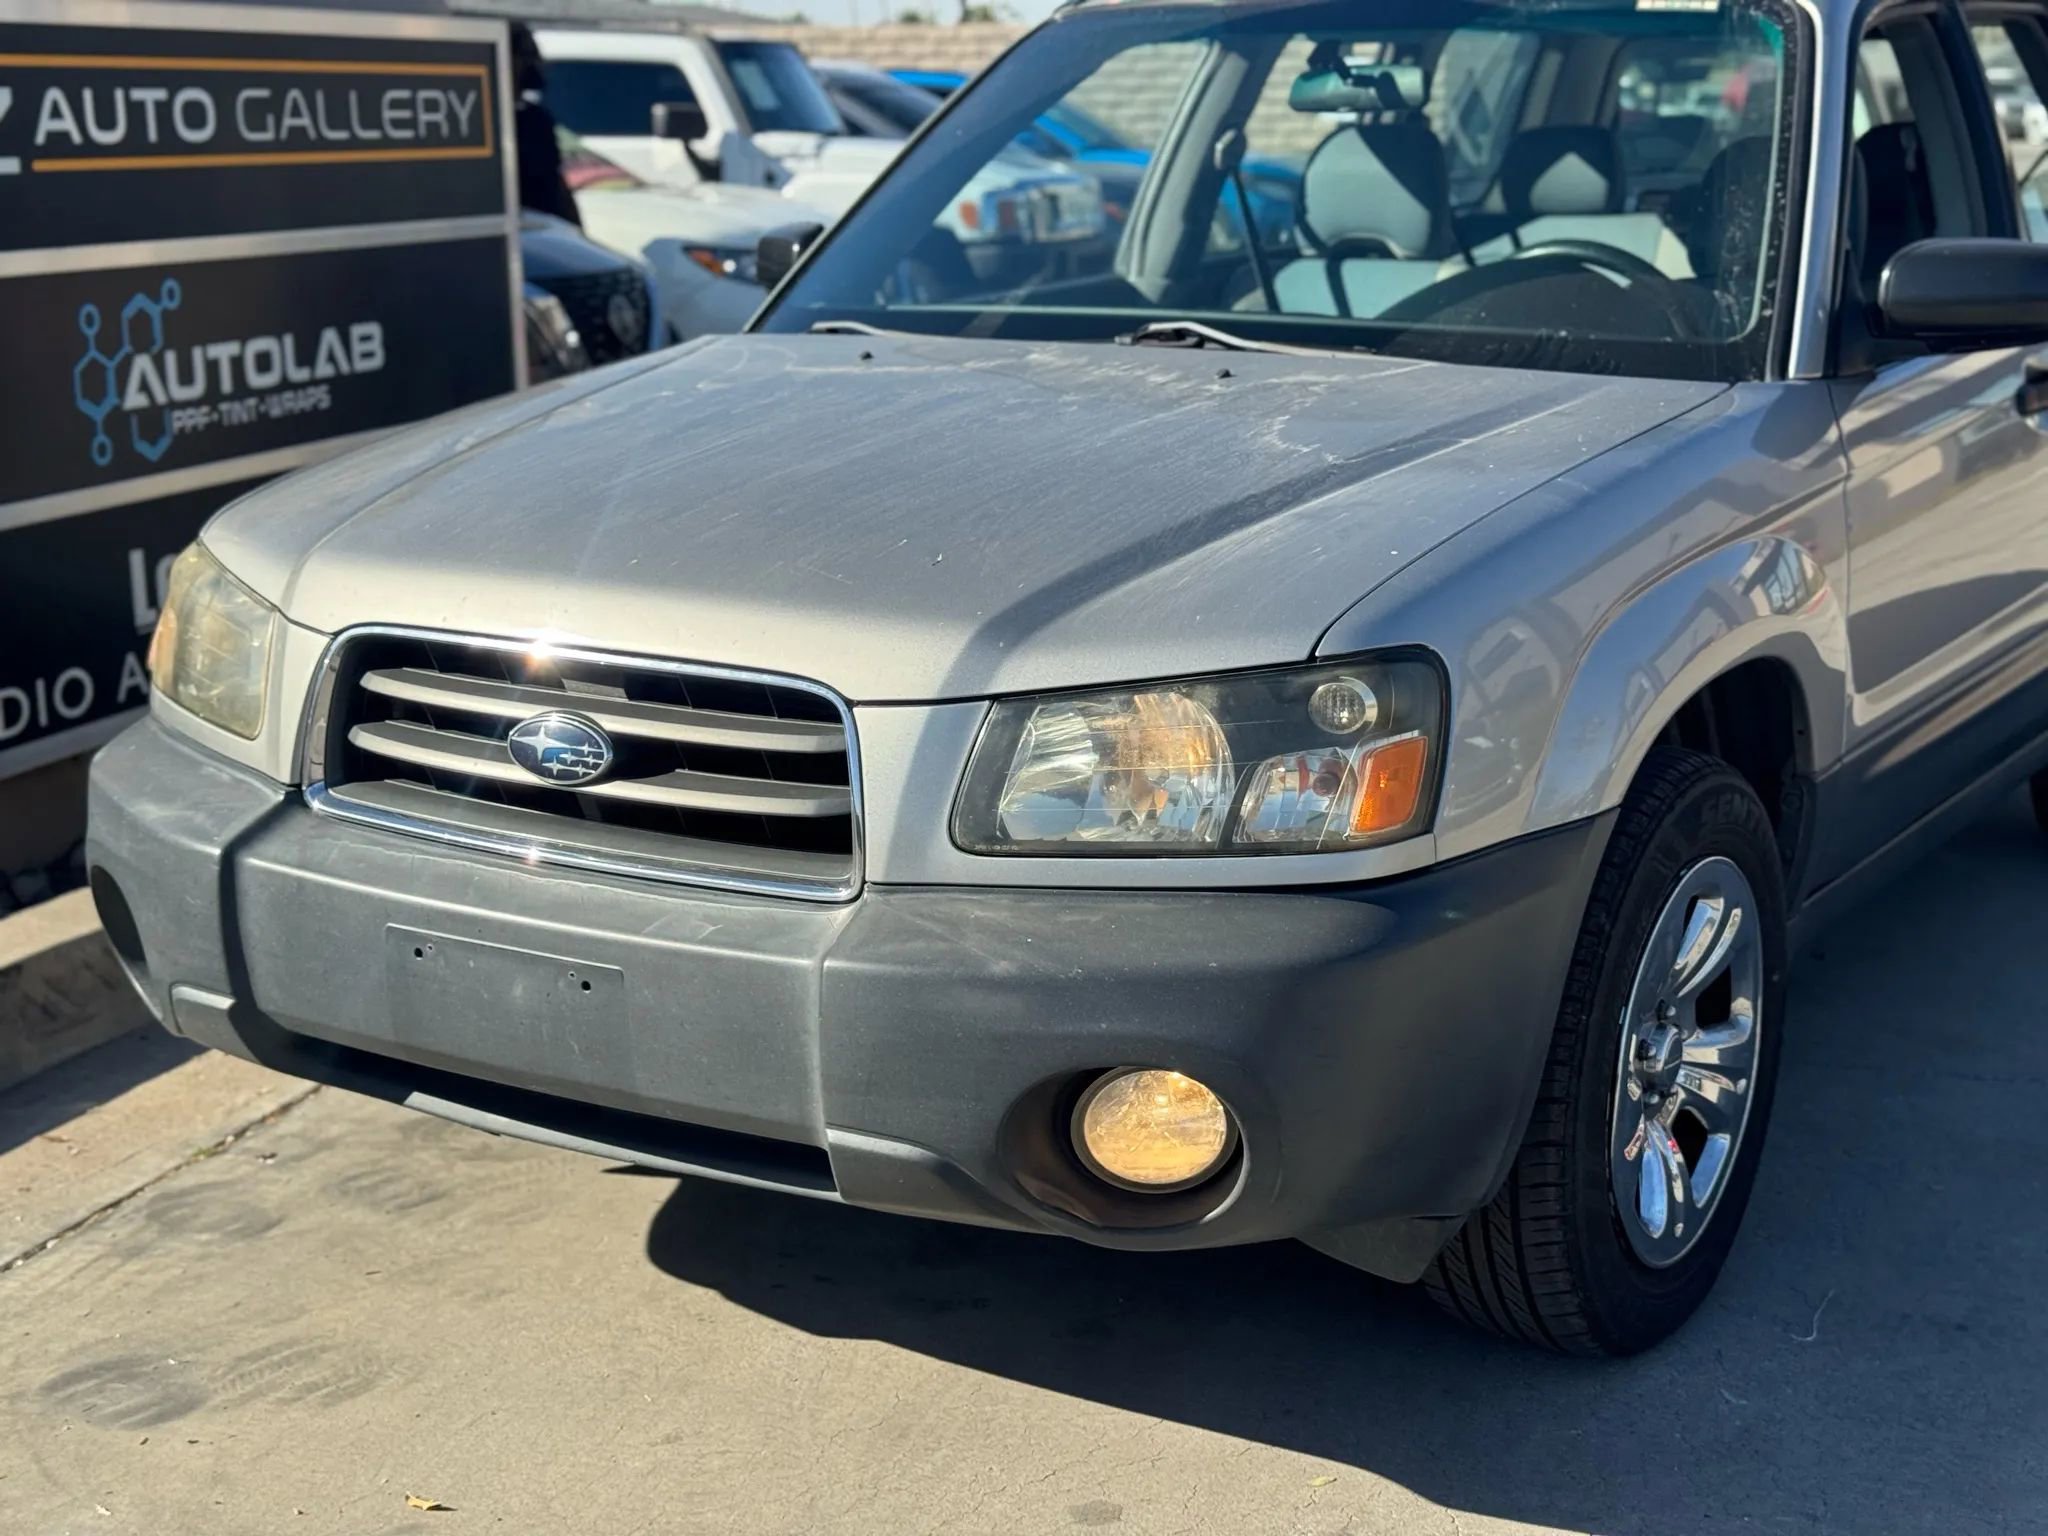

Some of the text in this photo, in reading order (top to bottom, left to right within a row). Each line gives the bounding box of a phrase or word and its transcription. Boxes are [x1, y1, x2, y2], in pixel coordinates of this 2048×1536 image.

[34, 86, 217, 146] AUTO
[236, 87, 477, 142] GALLERY
[121, 320, 386, 412] AUTOLAB
